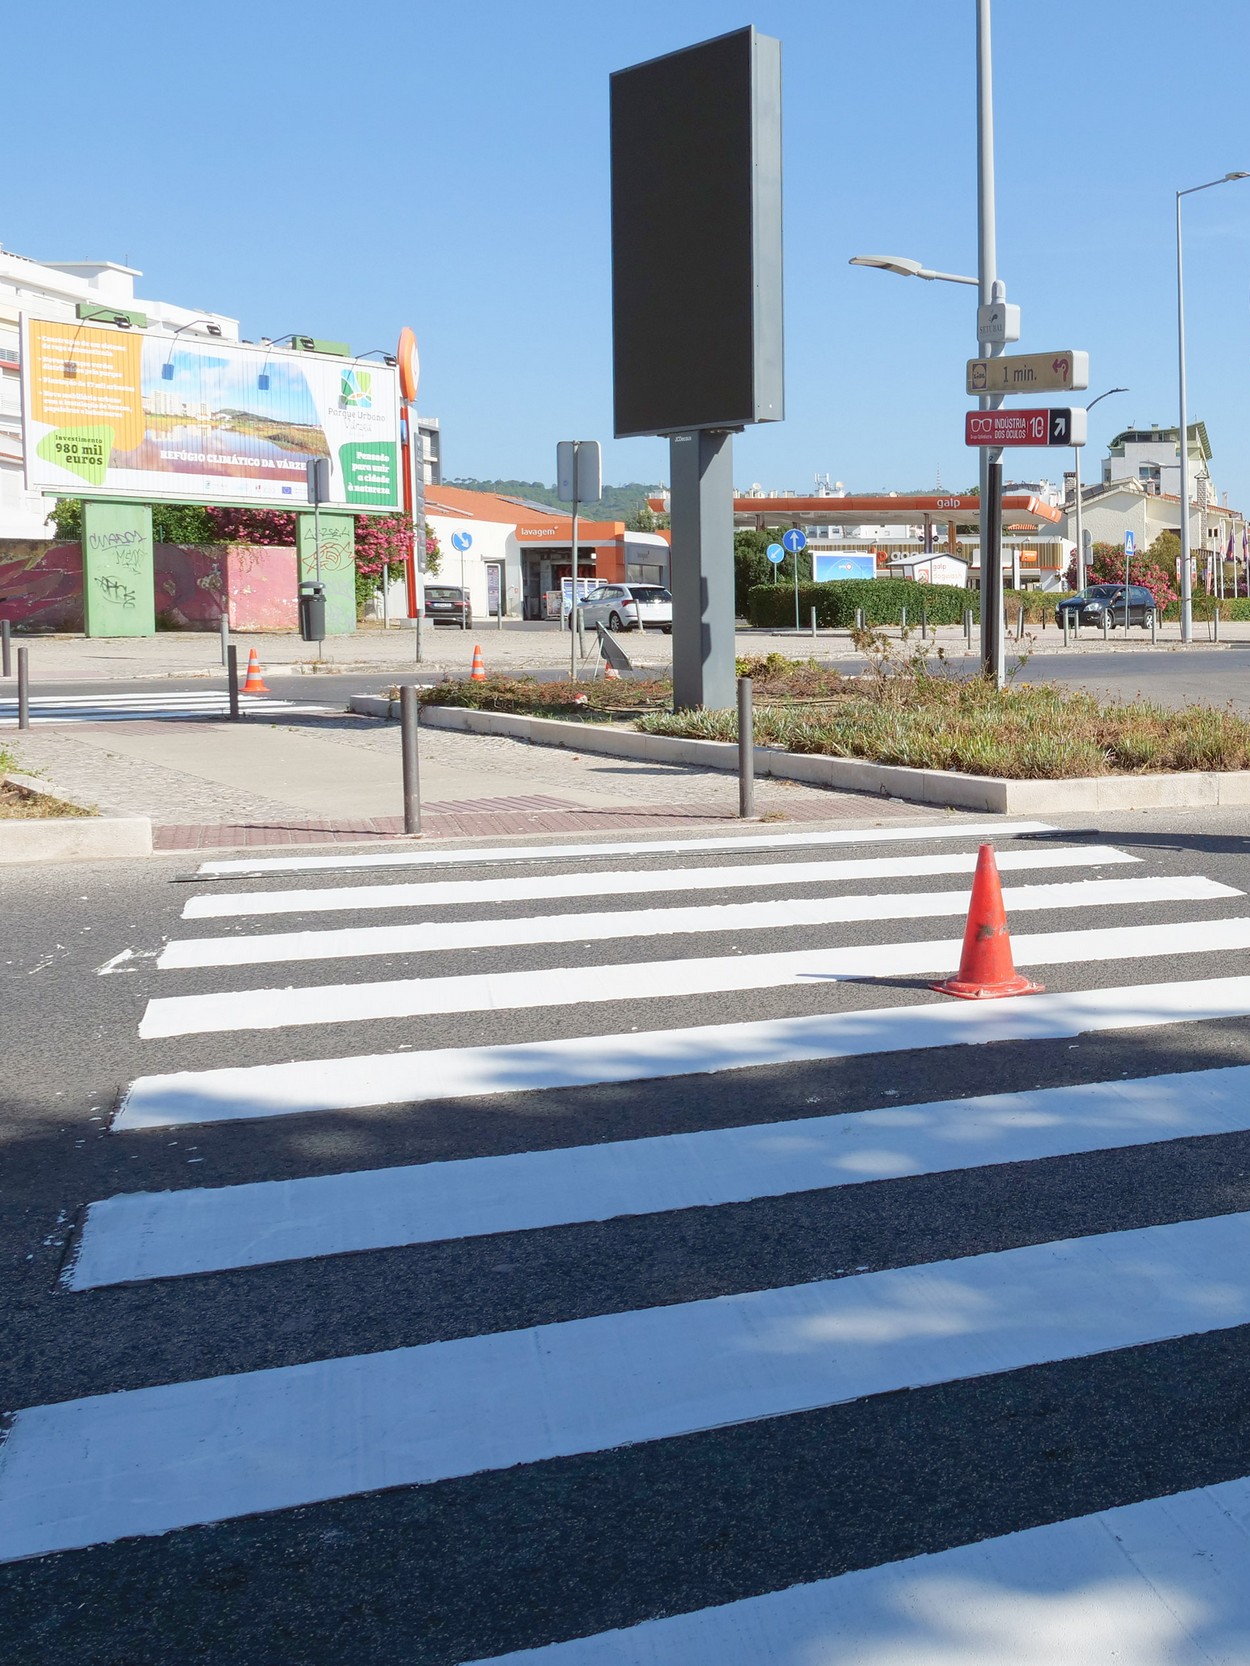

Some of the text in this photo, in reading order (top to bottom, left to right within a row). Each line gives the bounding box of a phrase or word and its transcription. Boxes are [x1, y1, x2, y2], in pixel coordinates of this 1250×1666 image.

[1003, 366, 1008, 383] 1
[1013, 364, 1037, 382] min.
[328, 407, 386, 422] Parque Urbano
[994, 416, 1044, 438] INDÚSTRIA 10
[994, 430, 1005, 439] DOS
[1006, 428, 1026, 439] ÓCULOS
[55, 435, 103, 444] Investimento
[55, 443, 103, 456] 980 mil
[65, 455, 103, 465] euros
[160, 449, 307, 471] REFÚGIO CLIMÁTICO DA VÁRZE
[356, 451, 390, 462] Pensado
[351, 463, 390, 473] para unir
[364, 473, 390, 484] cidade
[353, 485, 391, 495] natureza
[936, 498, 961, 509] galp
[521, 528, 555, 537] lavagem
[932, 563, 947, 571] galp
